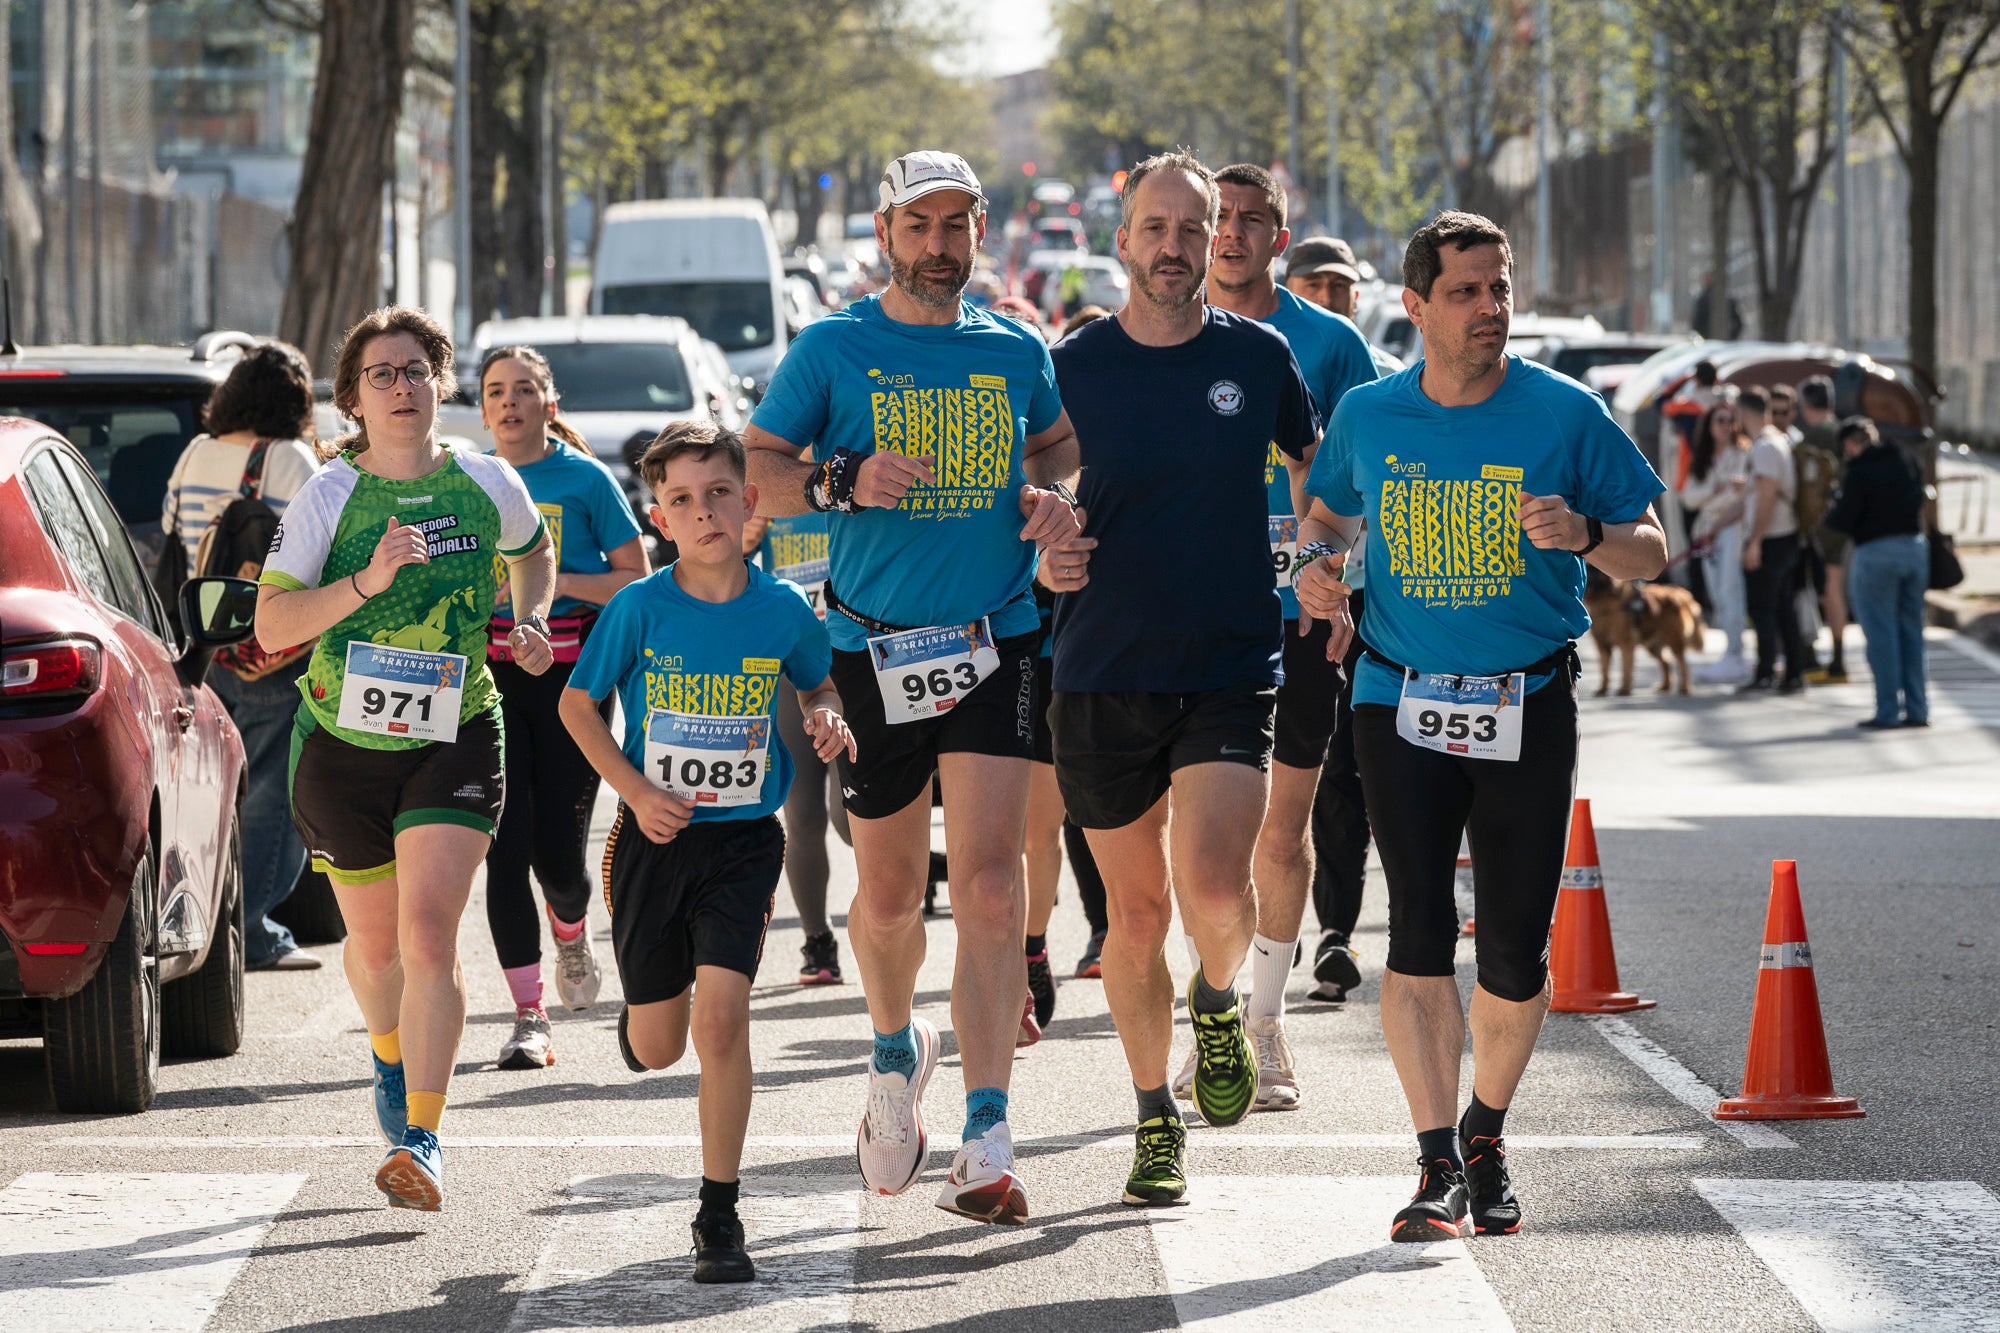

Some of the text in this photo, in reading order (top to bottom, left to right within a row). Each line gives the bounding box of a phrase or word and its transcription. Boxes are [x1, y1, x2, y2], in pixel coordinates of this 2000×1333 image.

[877, 374, 914, 385] avan
[1215, 393, 1238, 403] X7
[1391, 462, 1426, 474] avan
[1492, 472, 1520, 480] Terrassa
[898, 498, 993, 510] ARKINSON
[415, 516, 456, 532] REDORS
[427, 533, 440, 542] de
[1448, 577, 1495, 585] PASSEJADA
[1402, 584, 1511, 598] PARKINSON
[894, 630, 965, 651] PARKINSON
[371, 655, 442, 671] PARKINSON
[902, 662, 979, 702] 963
[1429, 678, 1499, 692] PRINSON
[363, 687, 432, 722] 971
[913, 705, 932, 714] avan
[363, 720, 383, 728] avan
[673, 722, 749, 735] PARKINSON
[1418, 710, 1497, 742] 953
[657, 755, 757, 789] 1083
